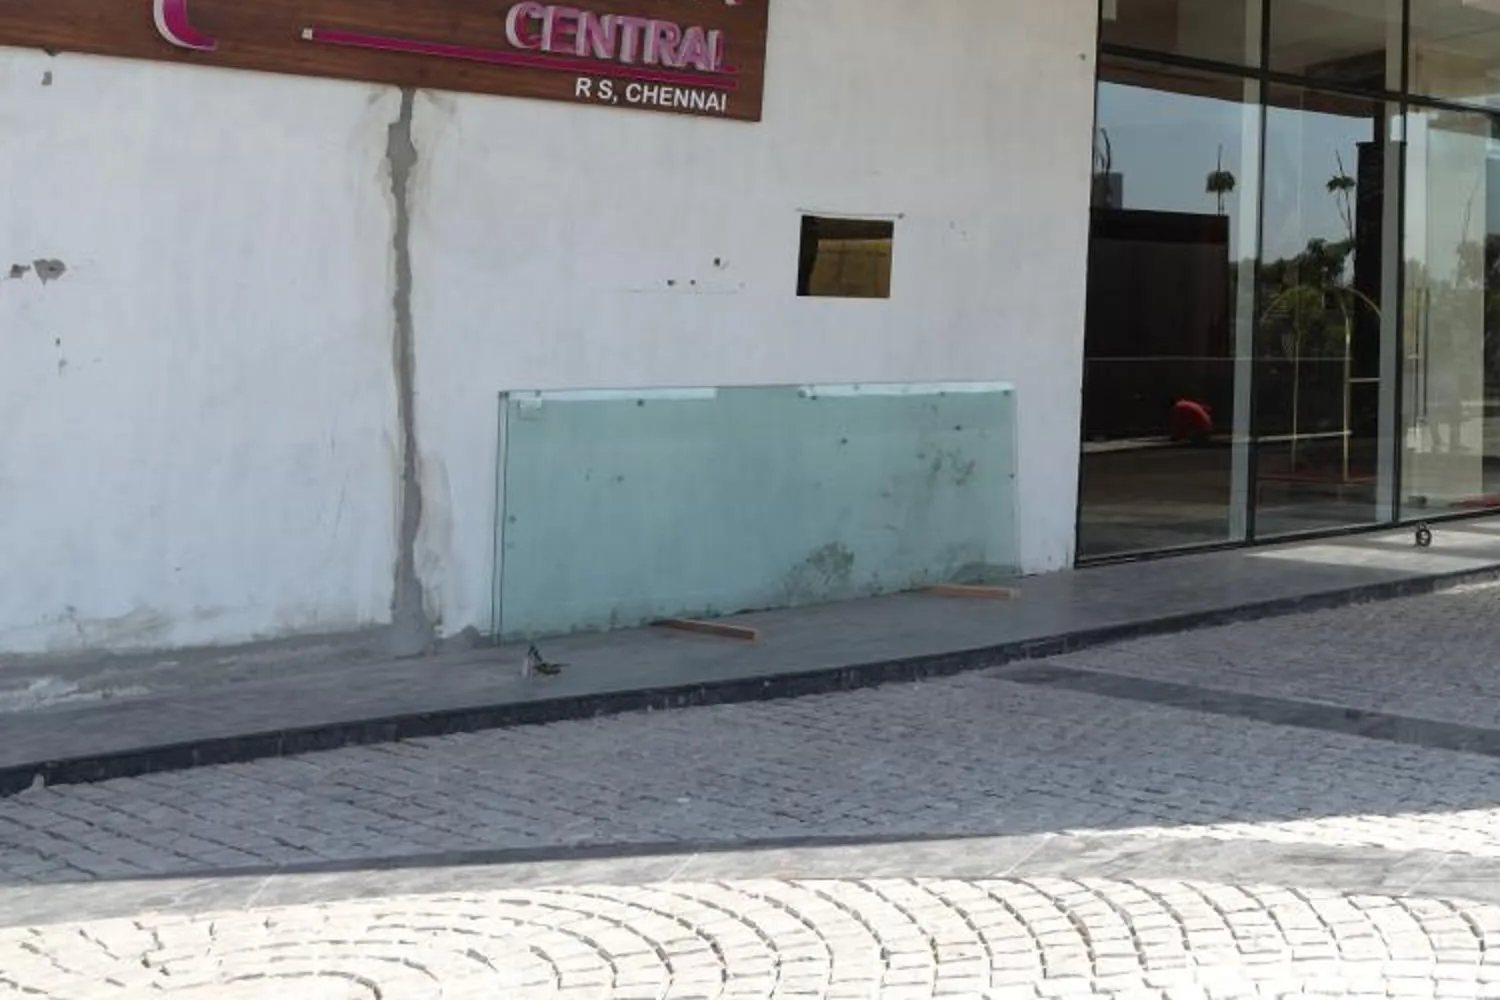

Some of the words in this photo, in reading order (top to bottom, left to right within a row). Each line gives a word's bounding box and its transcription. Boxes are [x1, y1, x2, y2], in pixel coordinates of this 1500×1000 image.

[505, 1, 738, 73] CENTRAL
[575, 77, 591, 98] R
[625, 83, 728, 112] CHENNAI
